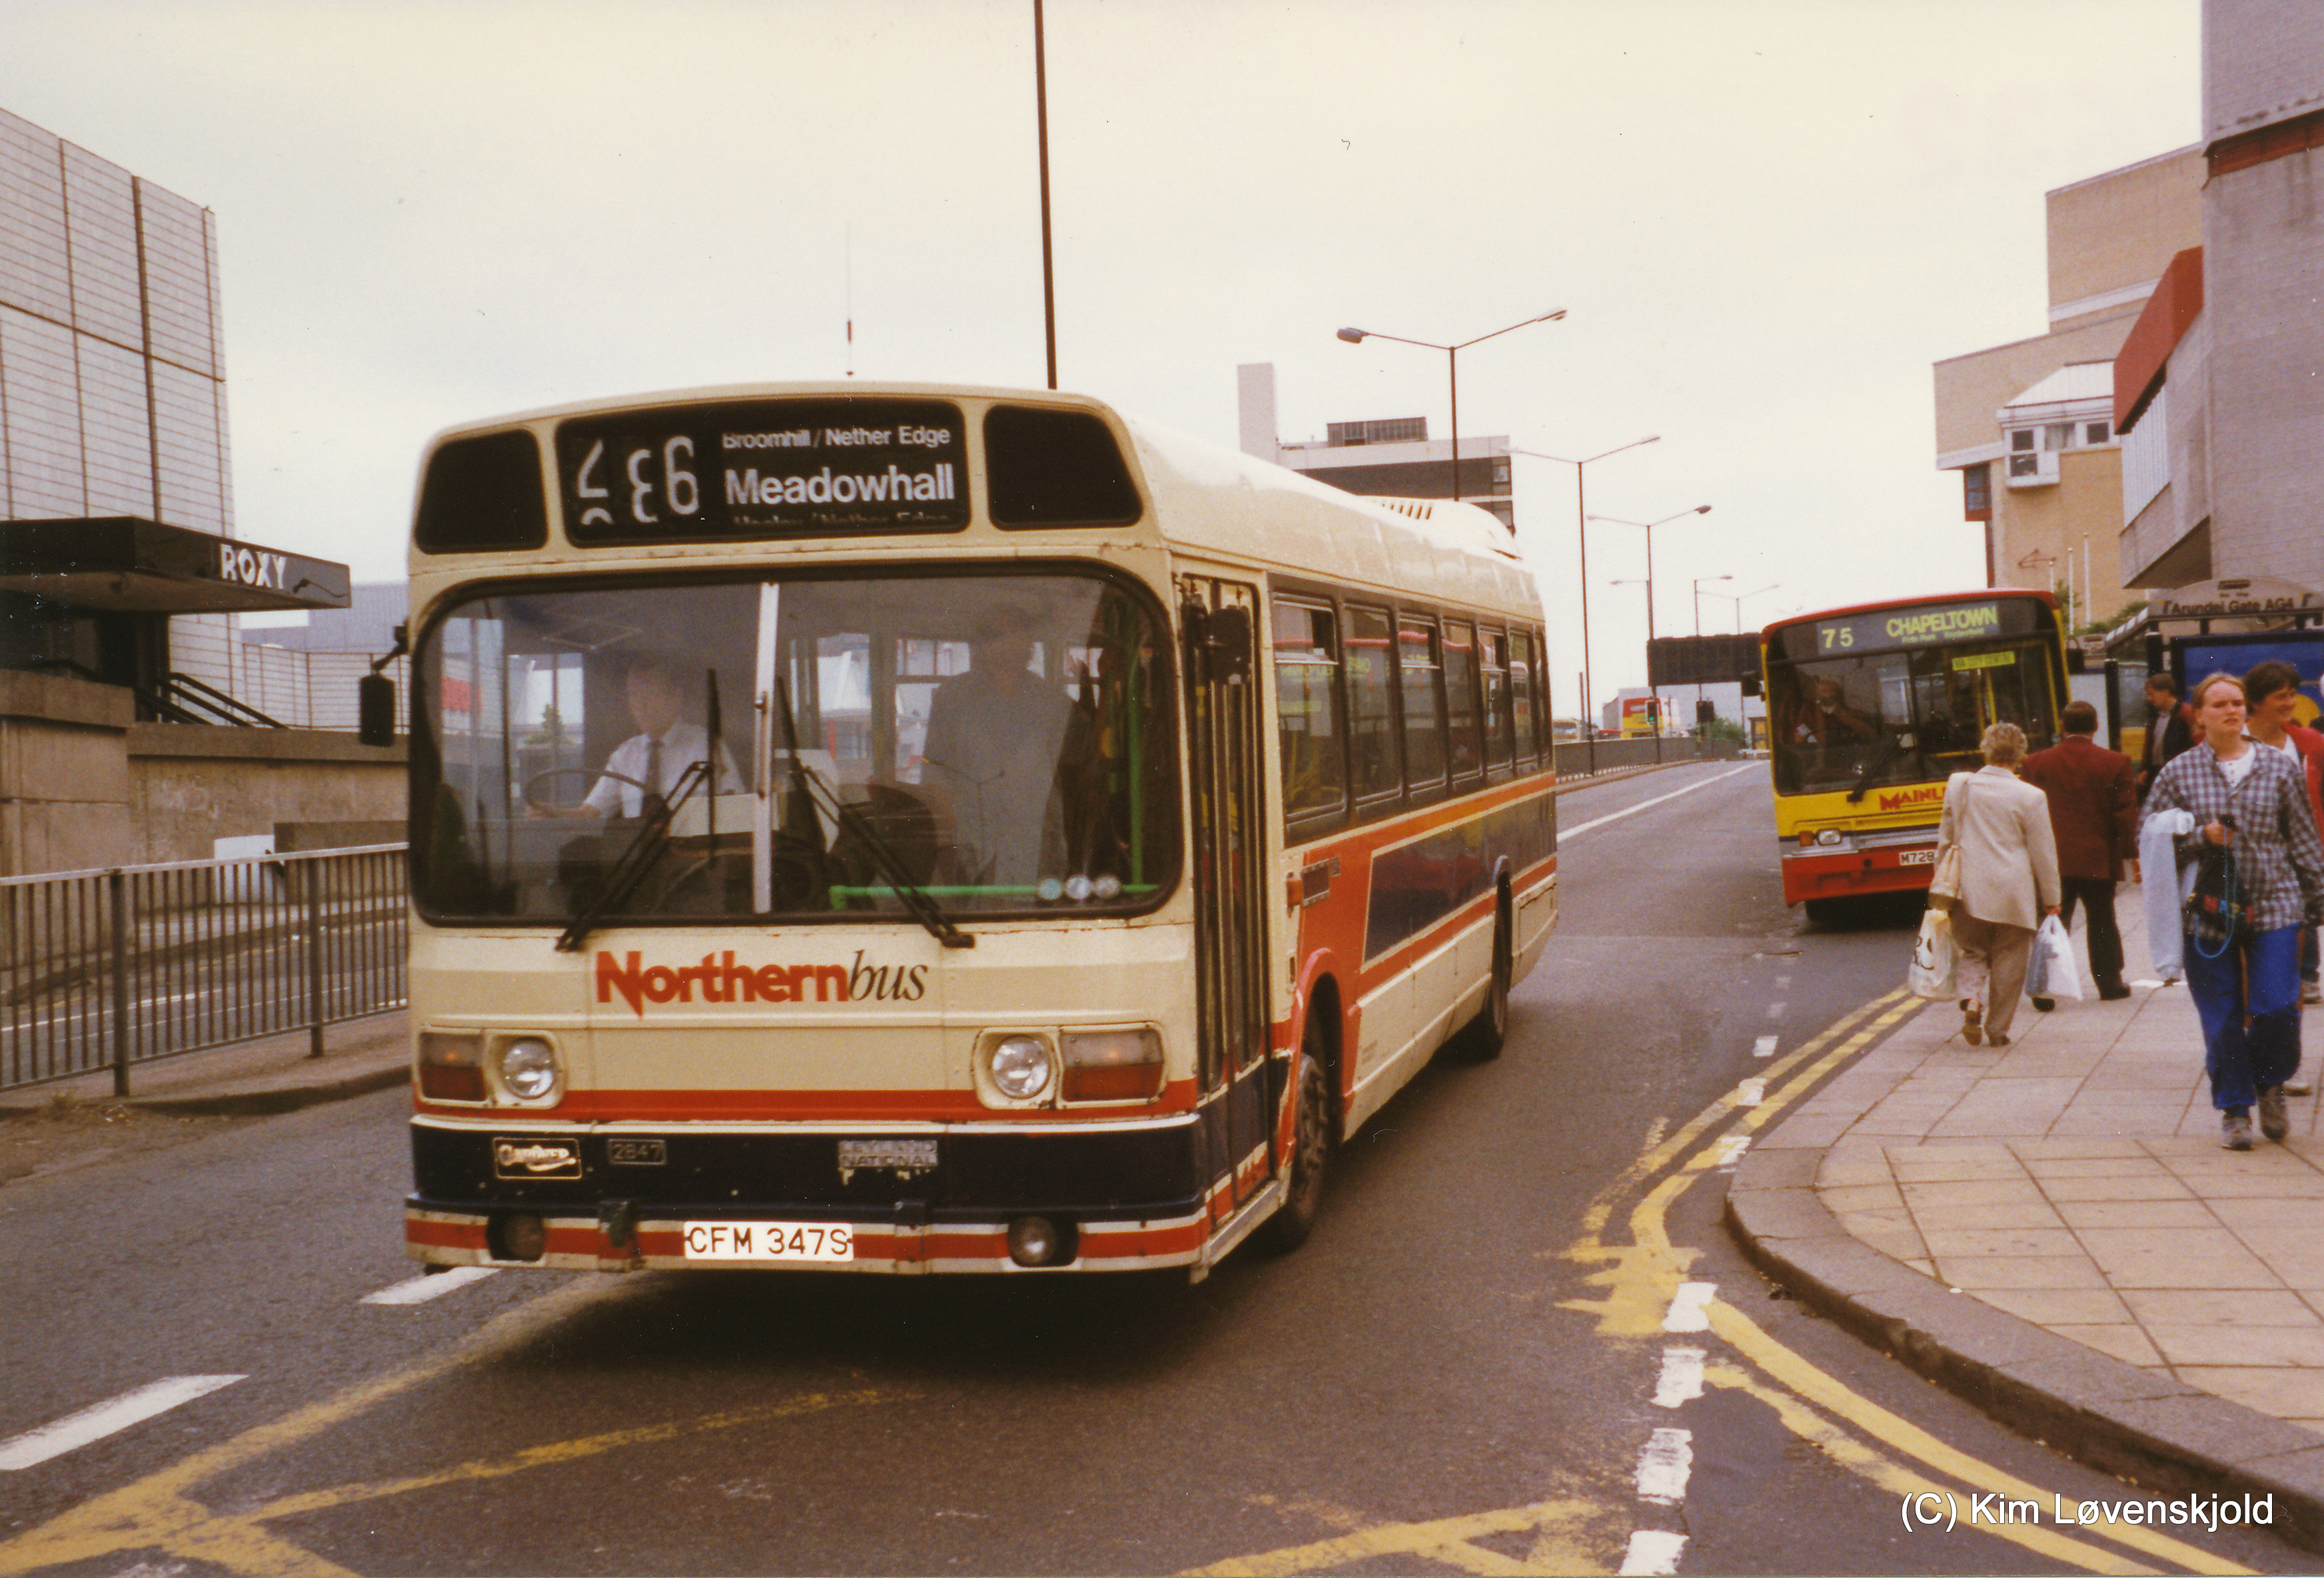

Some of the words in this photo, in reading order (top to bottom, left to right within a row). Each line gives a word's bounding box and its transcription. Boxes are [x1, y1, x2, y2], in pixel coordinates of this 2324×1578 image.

[723, 430, 811, 448] Broomhill
[826, 428, 891, 446] Nether
[898, 426, 951, 448] Edge
[725, 463, 955, 504] Meadowhall
[220, 543, 287, 590] ROXY
[1886, 606, 1998, 637] CHAPELTOWN
[2171, 602, 2224, 615] Arundel
[2229, 600, 2260, 613] Gate
[1822, 627, 1854, 649] 75
[690, 1226, 752, 1253] CFM
[767, 1227, 848, 1255] 347S
